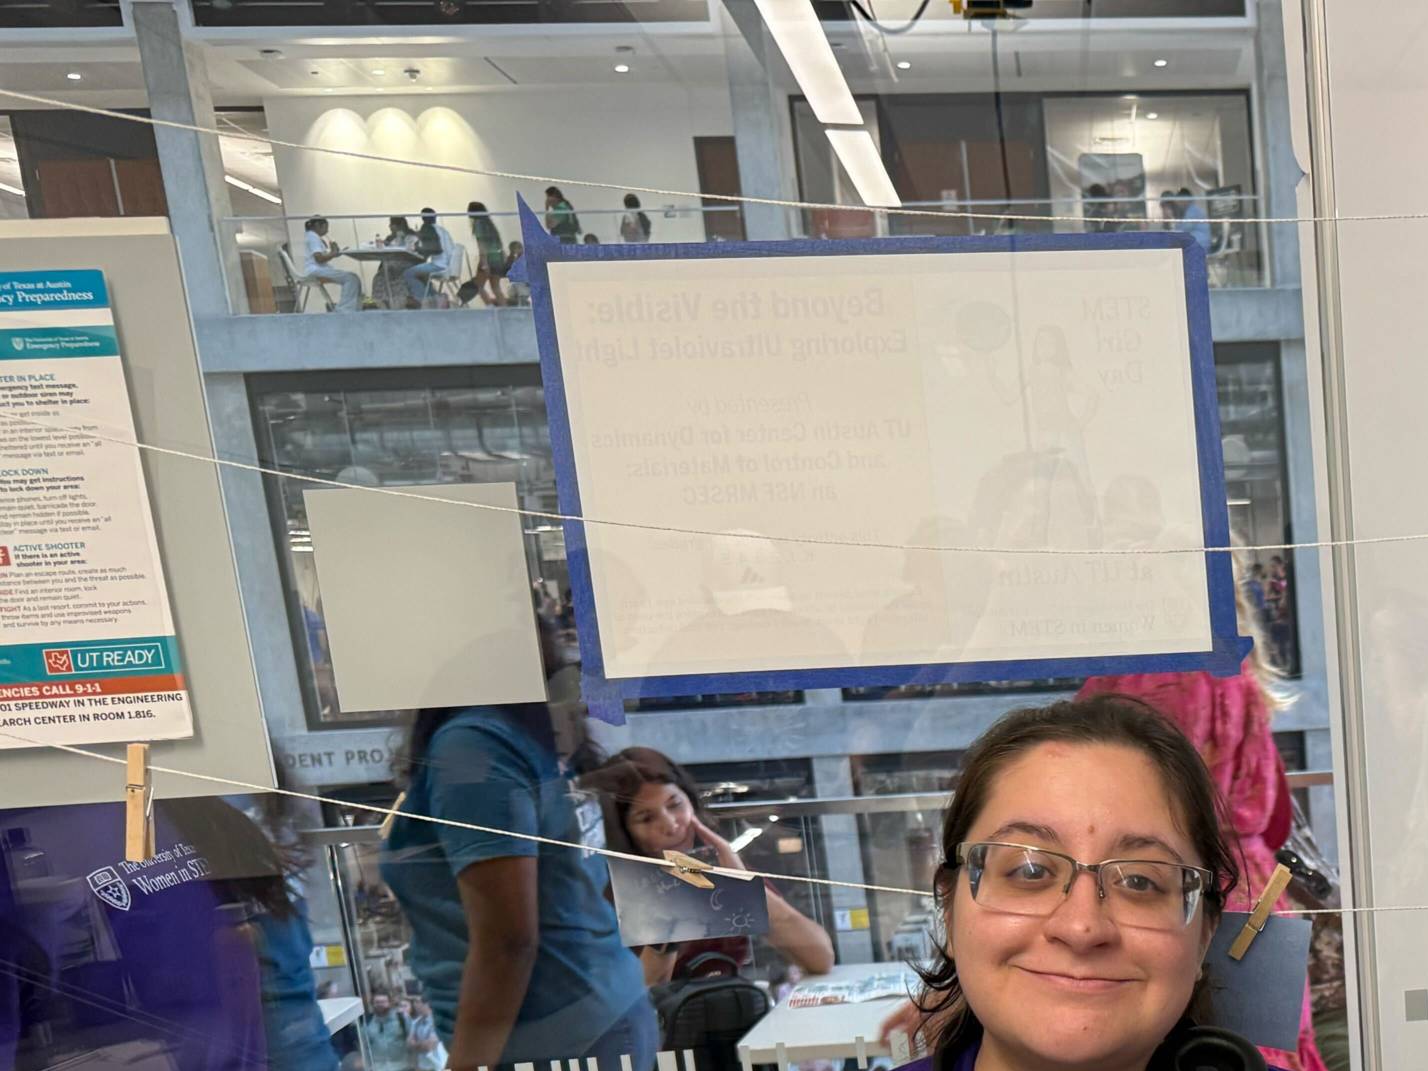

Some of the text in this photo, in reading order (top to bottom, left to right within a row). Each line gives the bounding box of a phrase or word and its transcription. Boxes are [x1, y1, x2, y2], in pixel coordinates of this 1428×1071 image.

[3, 281, 11, 289] of
[12, 281, 34, 289] Texas
[46, 281, 72, 289] Austin
[16, 290, 94, 304] Preparedness
[28, 373, 56, 381] PLACE
[0, 467, 48, 476] OCK DOWN
[13, 542, 86, 552] ACTIVE SHOOTER
[77, 649, 155, 668] UT READY
[0, 682, 102, 698] NCIES CALL 9-1-1
[14, 699, 71, 712] SPEEDWAY
[74, 698, 85, 708] IN
[87, 697, 108, 707] THE
[111, 693, 183, 706] ENGINEERING
[36, 714, 76, 725] CENTER
[79, 713, 91, 722] IN
[93, 711, 125, 721] ROOM
[127, 709, 156, 720] 1.816.
[118, 860, 140, 875] The
[132, 857, 212, 896] Women in STE
